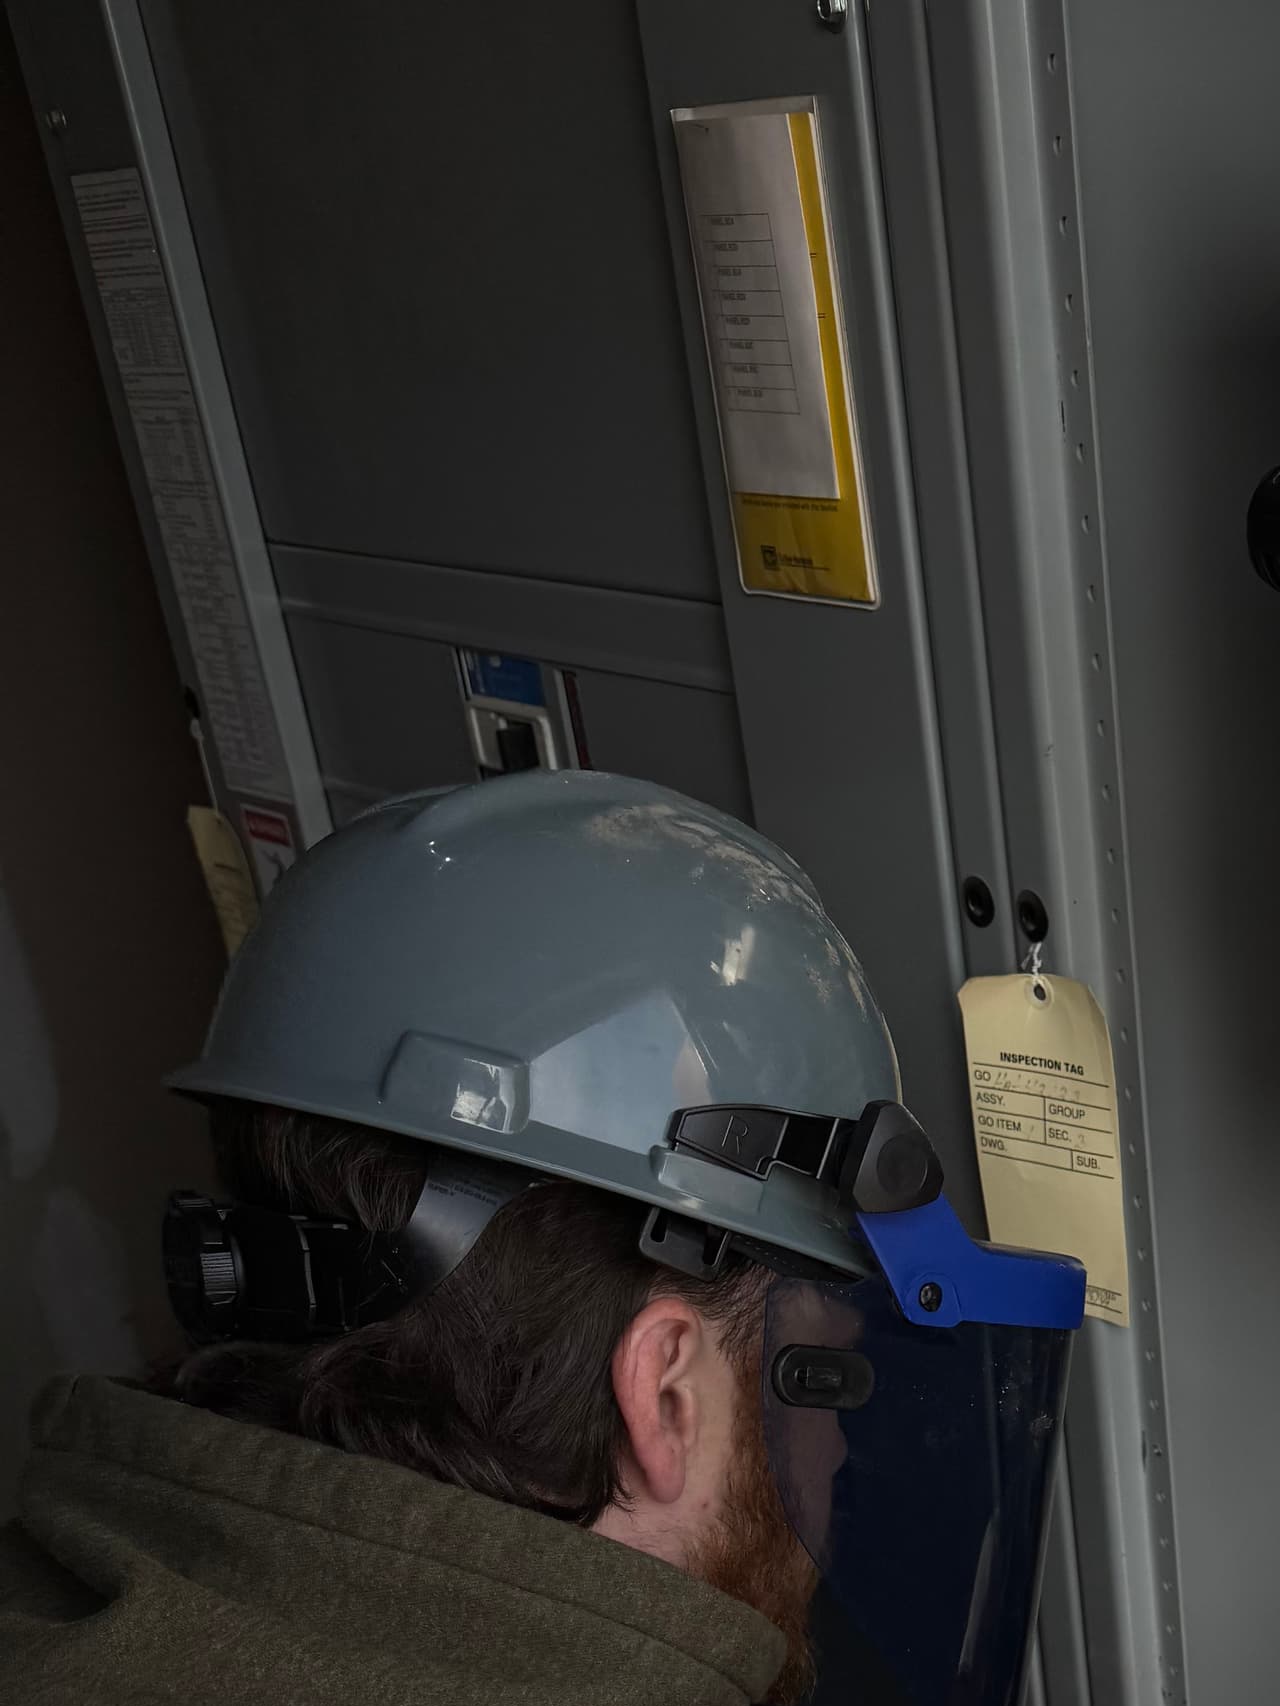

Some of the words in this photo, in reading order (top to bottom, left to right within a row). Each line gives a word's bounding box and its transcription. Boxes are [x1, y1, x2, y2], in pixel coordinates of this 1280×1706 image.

[1000, 1051, 1062, 1072] INSPECTION
[1063, 1062, 1084, 1076] TAG
[974, 1069, 991, 1082] GO
[976, 1091, 1006, 1106] ASSY.
[1048, 1103, 1086, 1120] GROUP
[977, 1114, 994, 1127] GO
[996, 1118, 1022, 1132] ITEM
[1047, 1126, 1072, 1143] SEC.
[980, 1136, 1008, 1152] DWG.
[1075, 1155, 1101, 1170] SUB.
